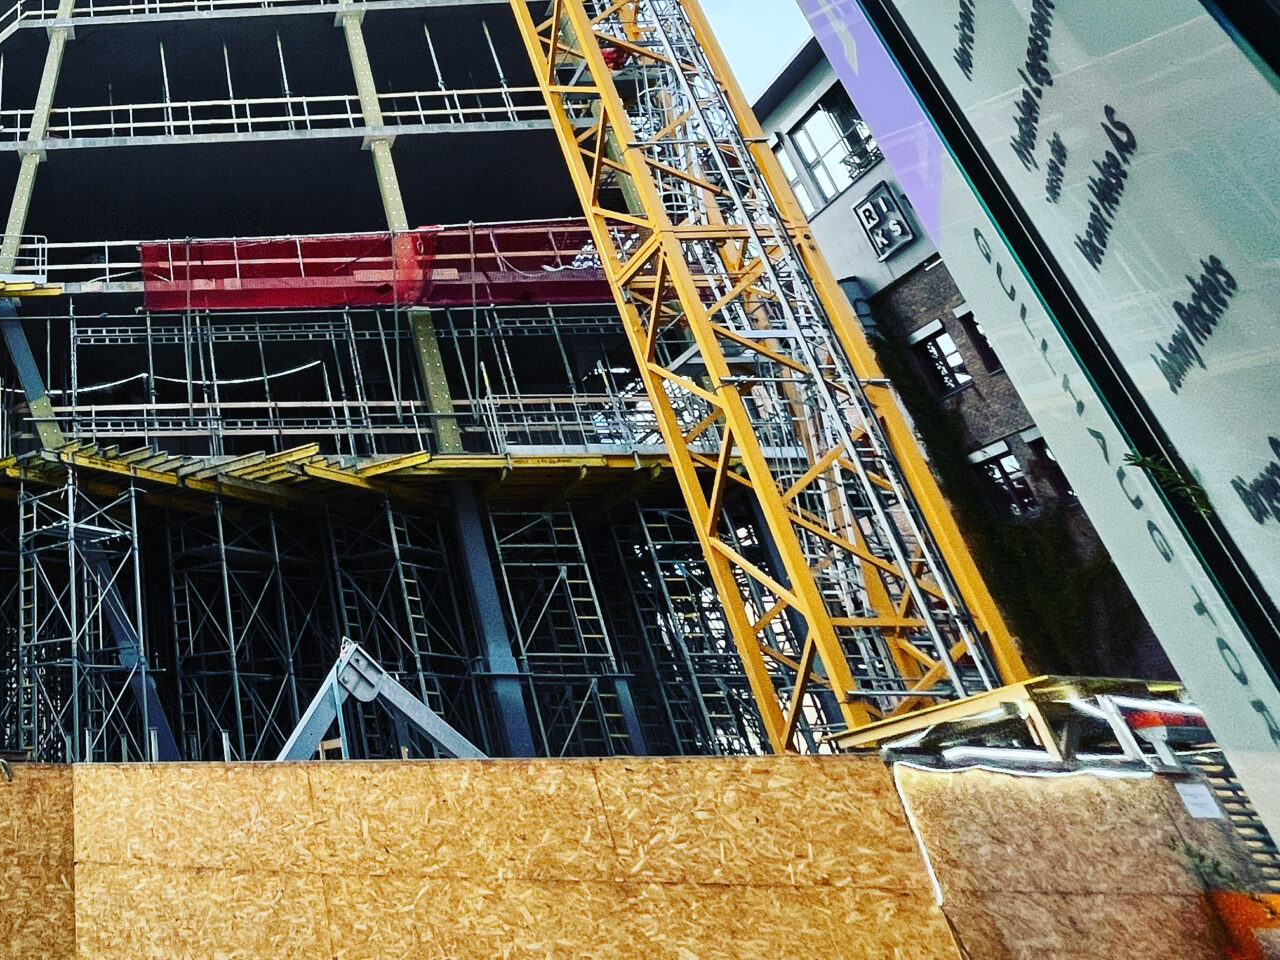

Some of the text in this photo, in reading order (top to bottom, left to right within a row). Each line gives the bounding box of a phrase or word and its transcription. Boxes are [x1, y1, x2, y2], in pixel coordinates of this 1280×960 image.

[1010, 88, 1040, 172] Nydalen
[1100, 104, 1138, 166] AS
[1087, 150, 1129, 220] Helse
[1150, 254, 1238, 395] Johnny Rockets
[973, 227, 1174, 563] GULLHAUG
